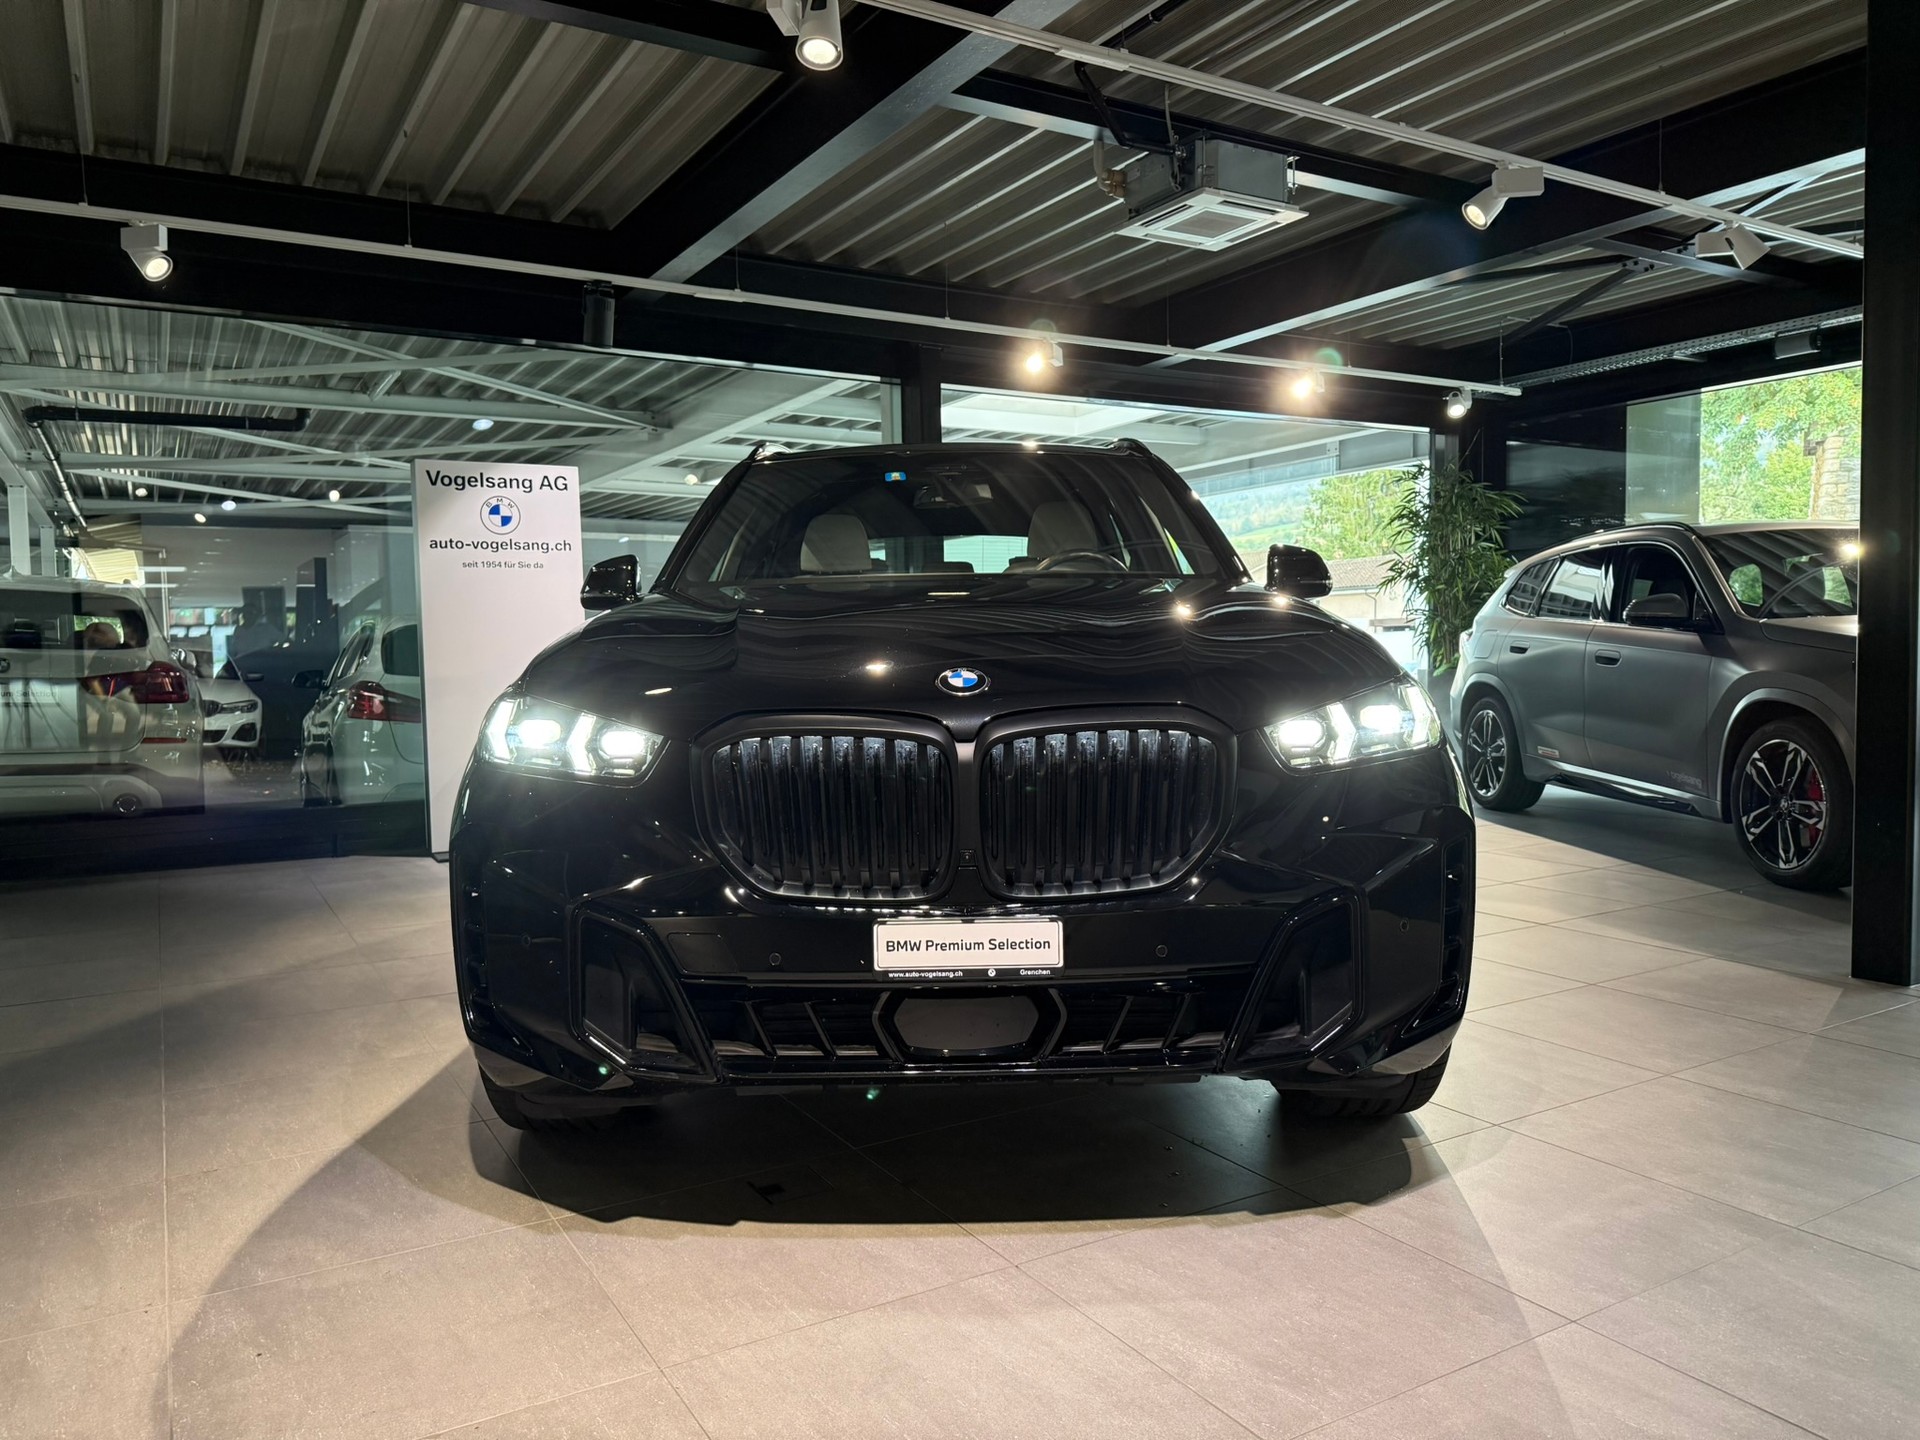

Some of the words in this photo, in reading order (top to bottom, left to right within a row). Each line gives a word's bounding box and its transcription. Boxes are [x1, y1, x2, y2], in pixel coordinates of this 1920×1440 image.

[425, 470, 534, 493] Vogelsang
[539, 475, 569, 492] AG
[485, 497, 516, 509] BMW
[429, 537, 572, 554] auto-vogelsang.ch
[462, 560, 479, 569] seit
[481, 560, 503, 569] 1954
[504, 560, 517, 569] für
[517, 560, 532, 569] Sie
[533, 561, 545, 569] da
[885, 940, 922, 953] BMW
[925, 938, 985, 952] Premium
[988, 937, 1051, 951] Selection
[888, 970, 964, 979] www.auto-vogelsang.ch
[1019, 968, 1051, 976] Grenchen
